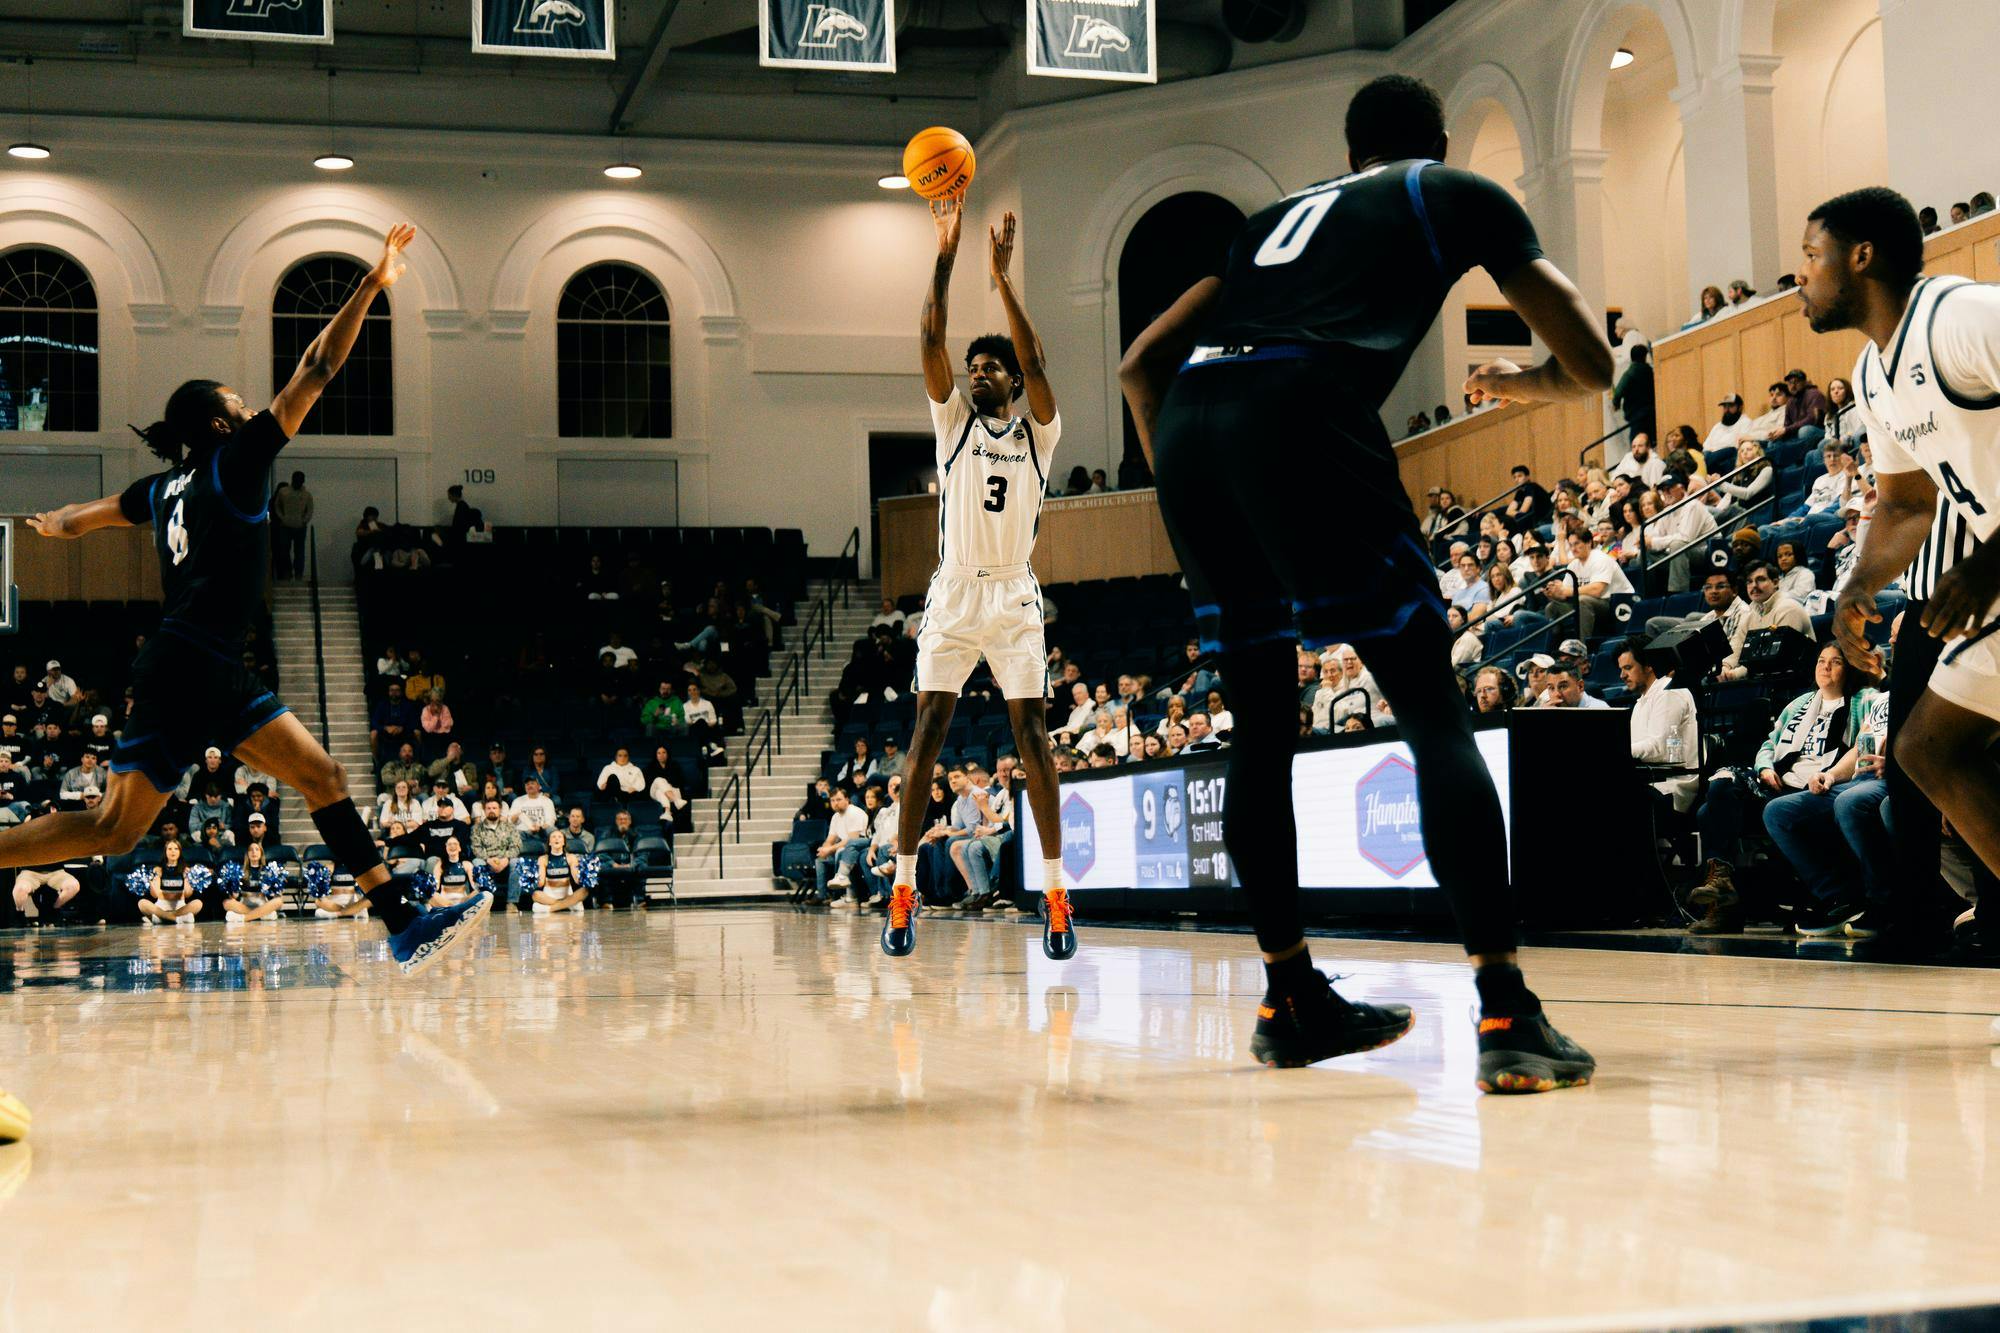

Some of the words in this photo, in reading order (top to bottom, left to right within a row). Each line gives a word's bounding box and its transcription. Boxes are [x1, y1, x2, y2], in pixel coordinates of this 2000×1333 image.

[918, 163, 948, 186] NCAA
[1254, 189, 1342, 267] 0
[972, 443, 1028, 465] Longwood
[464, 469, 495, 484] 109
[1938, 460, 1987, 516] 4
[983, 475, 1008, 513] 3
[1187, 777, 1226, 815] 15:17
[1142, 789, 1156, 840] 9
[1204, 821, 1224, 842] HALF
[1192, 858, 1210, 875] SHOT
[1212, 852, 1227, 880] 18
